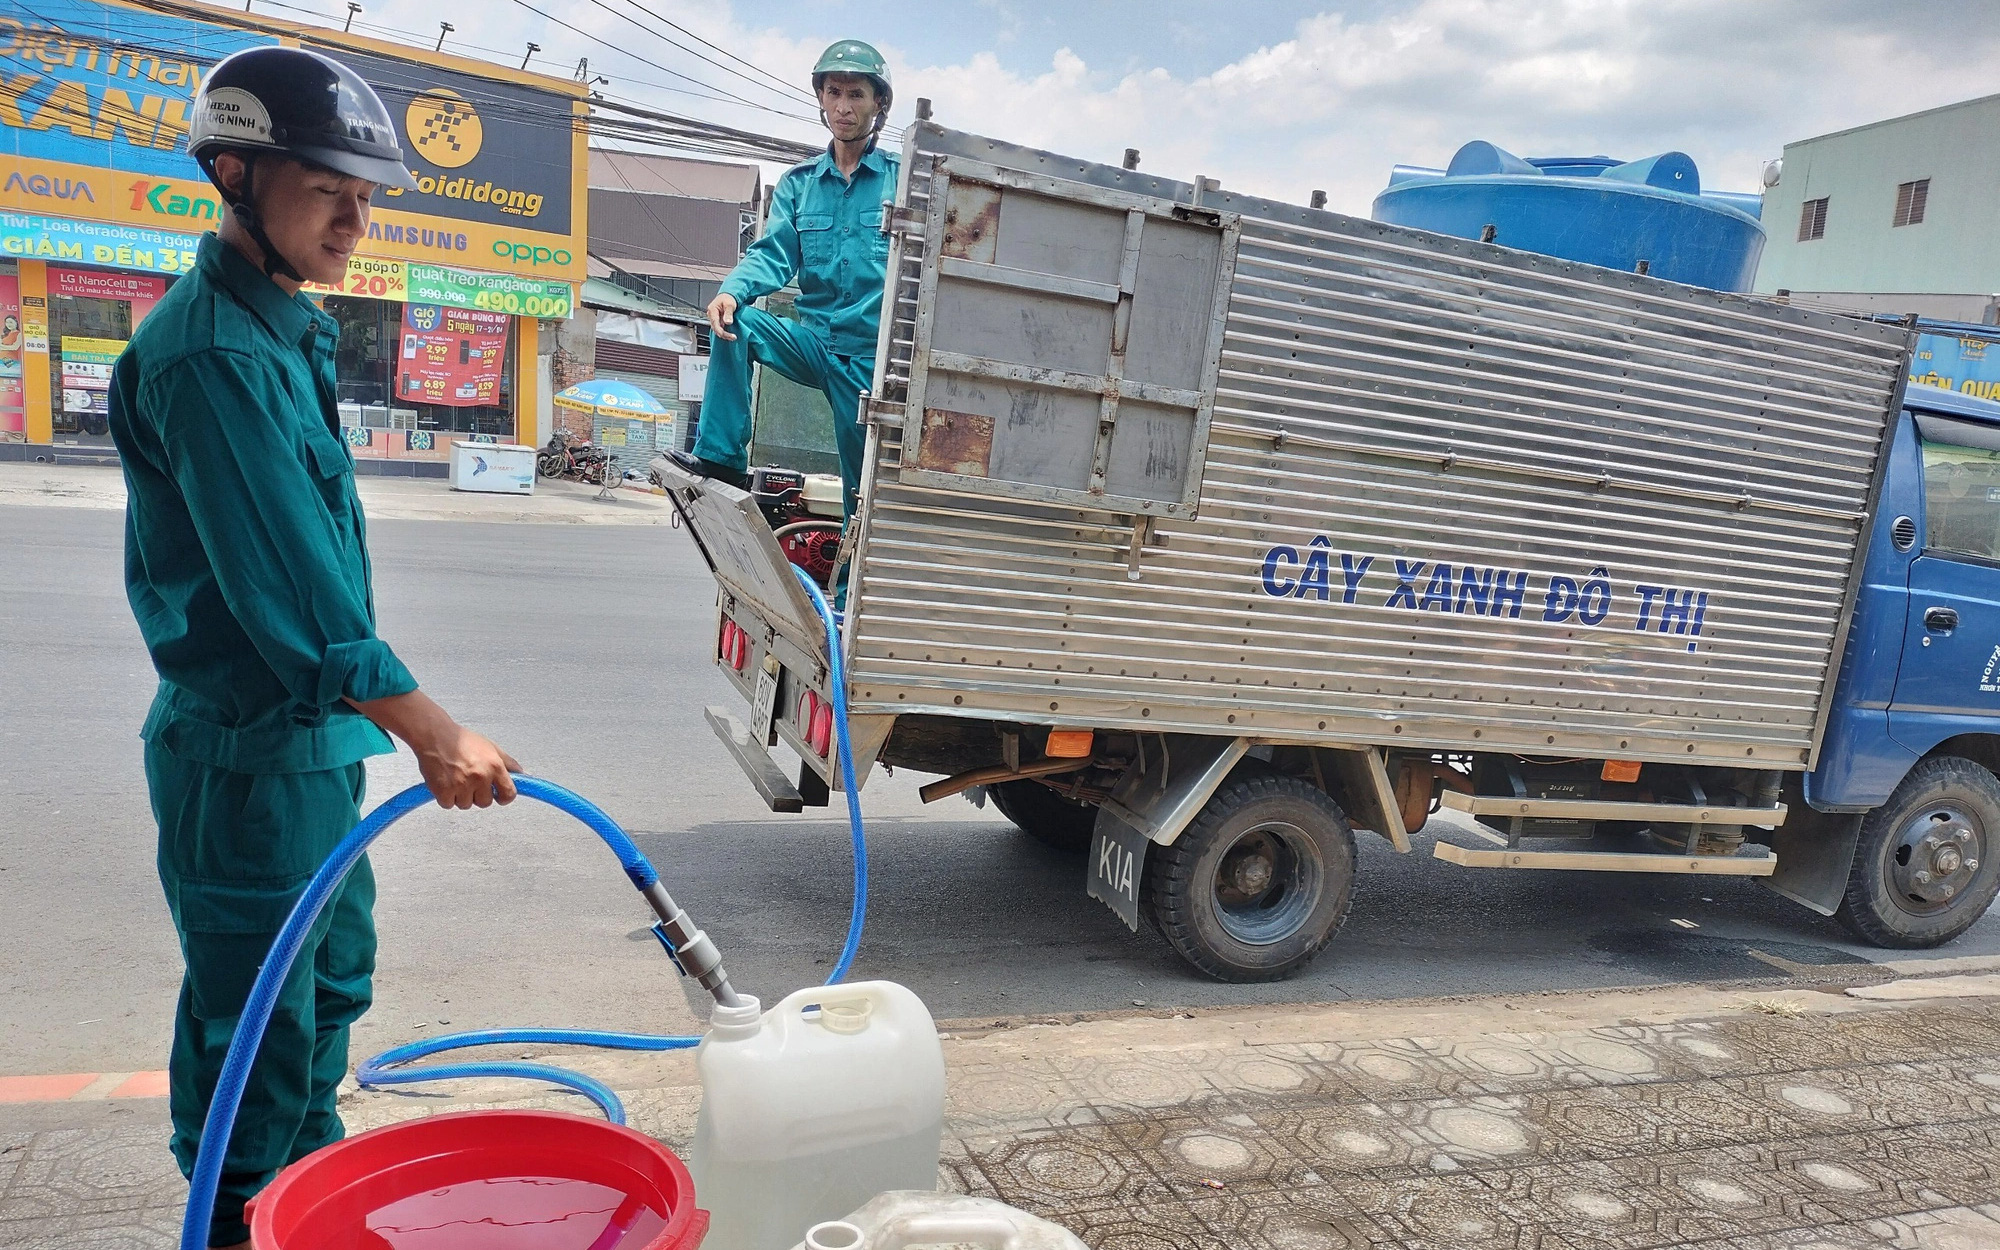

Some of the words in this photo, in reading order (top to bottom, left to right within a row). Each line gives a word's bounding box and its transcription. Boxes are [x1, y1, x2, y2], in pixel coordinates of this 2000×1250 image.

[210, 102, 240, 112] HEAD
[226, 114, 256, 129] NINH
[347, 118, 374, 129] TRANG
[4, 172, 95, 203] AQUA
[42, 218, 71, 233] Loa
[74, 222, 138, 241] Karaoke
[141, 229, 162, 244] trả
[164, 232, 193, 248] góp
[368, 221, 468, 251] AMSUNG
[3, 233, 83, 260] GIẢM
[92, 242, 155, 268] ĐẾN
[364, 260, 389, 274] góp
[60, 273, 76, 283] LG
[78, 275, 126, 288] NanoCell
[350, 273, 404, 297] 20%
[411, 266, 445, 284] quạt
[447, 271, 476, 286] treo
[478, 275, 543, 295] kangaroo
[6, 304, 18, 312] LG
[473, 291, 568, 317] 490.000
[447, 319, 454, 331] 5
[455, 321, 475, 335] ngày
[766, 474, 797, 482] CYCLONE
[1261, 535, 1375, 605] CÂY
[1384, 556, 1529, 621] XANH
[1541, 566, 1613, 628] ĐÔ
[1633, 584, 1709, 654] THỊ
[1099, 835, 1133, 902] KIA
